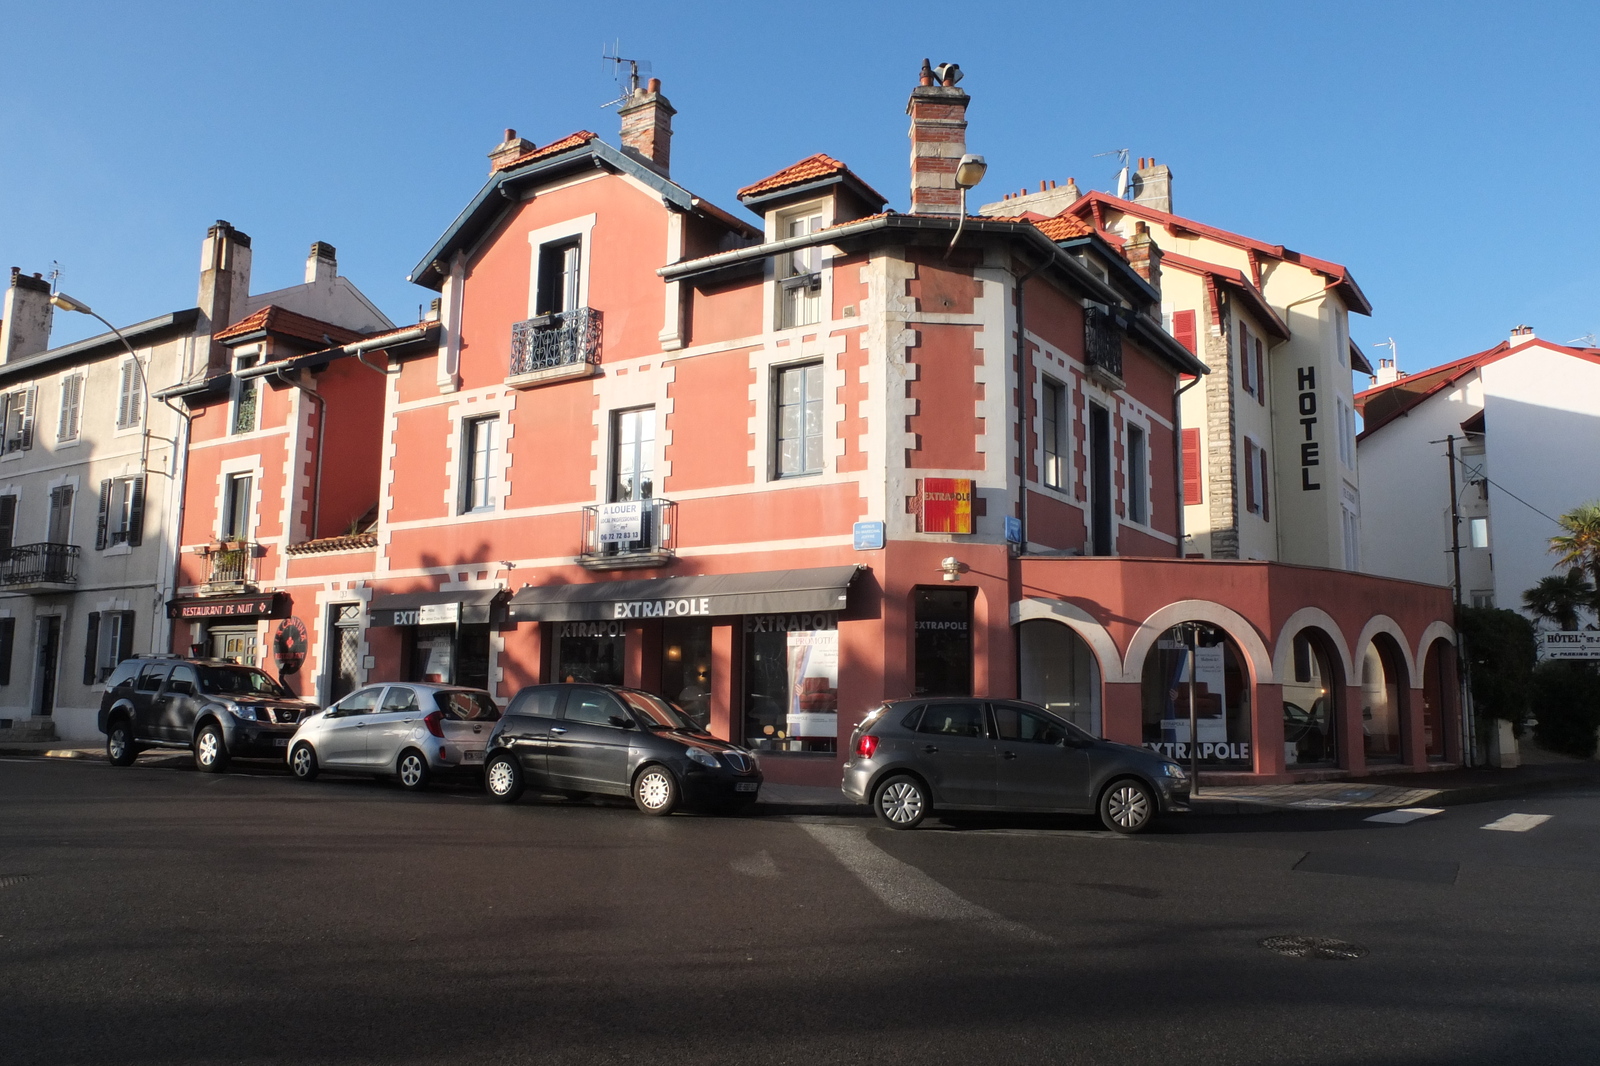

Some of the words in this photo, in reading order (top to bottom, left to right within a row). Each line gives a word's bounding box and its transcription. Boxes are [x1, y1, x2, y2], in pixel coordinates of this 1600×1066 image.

[1297, 366, 1321, 491] HOTEL
[924, 492, 970, 502] EXTRAPOLE
[603, 507, 609, 515] A
[611, 504, 637, 514] LOUER
[182, 606, 224, 616] RESTAURANT
[225, 605, 235, 614] DE
[237, 603, 255, 613] NUIT
[613, 598, 710, 619] EXTRAPOLE
[1547, 633, 1581, 643] HÔTEL
